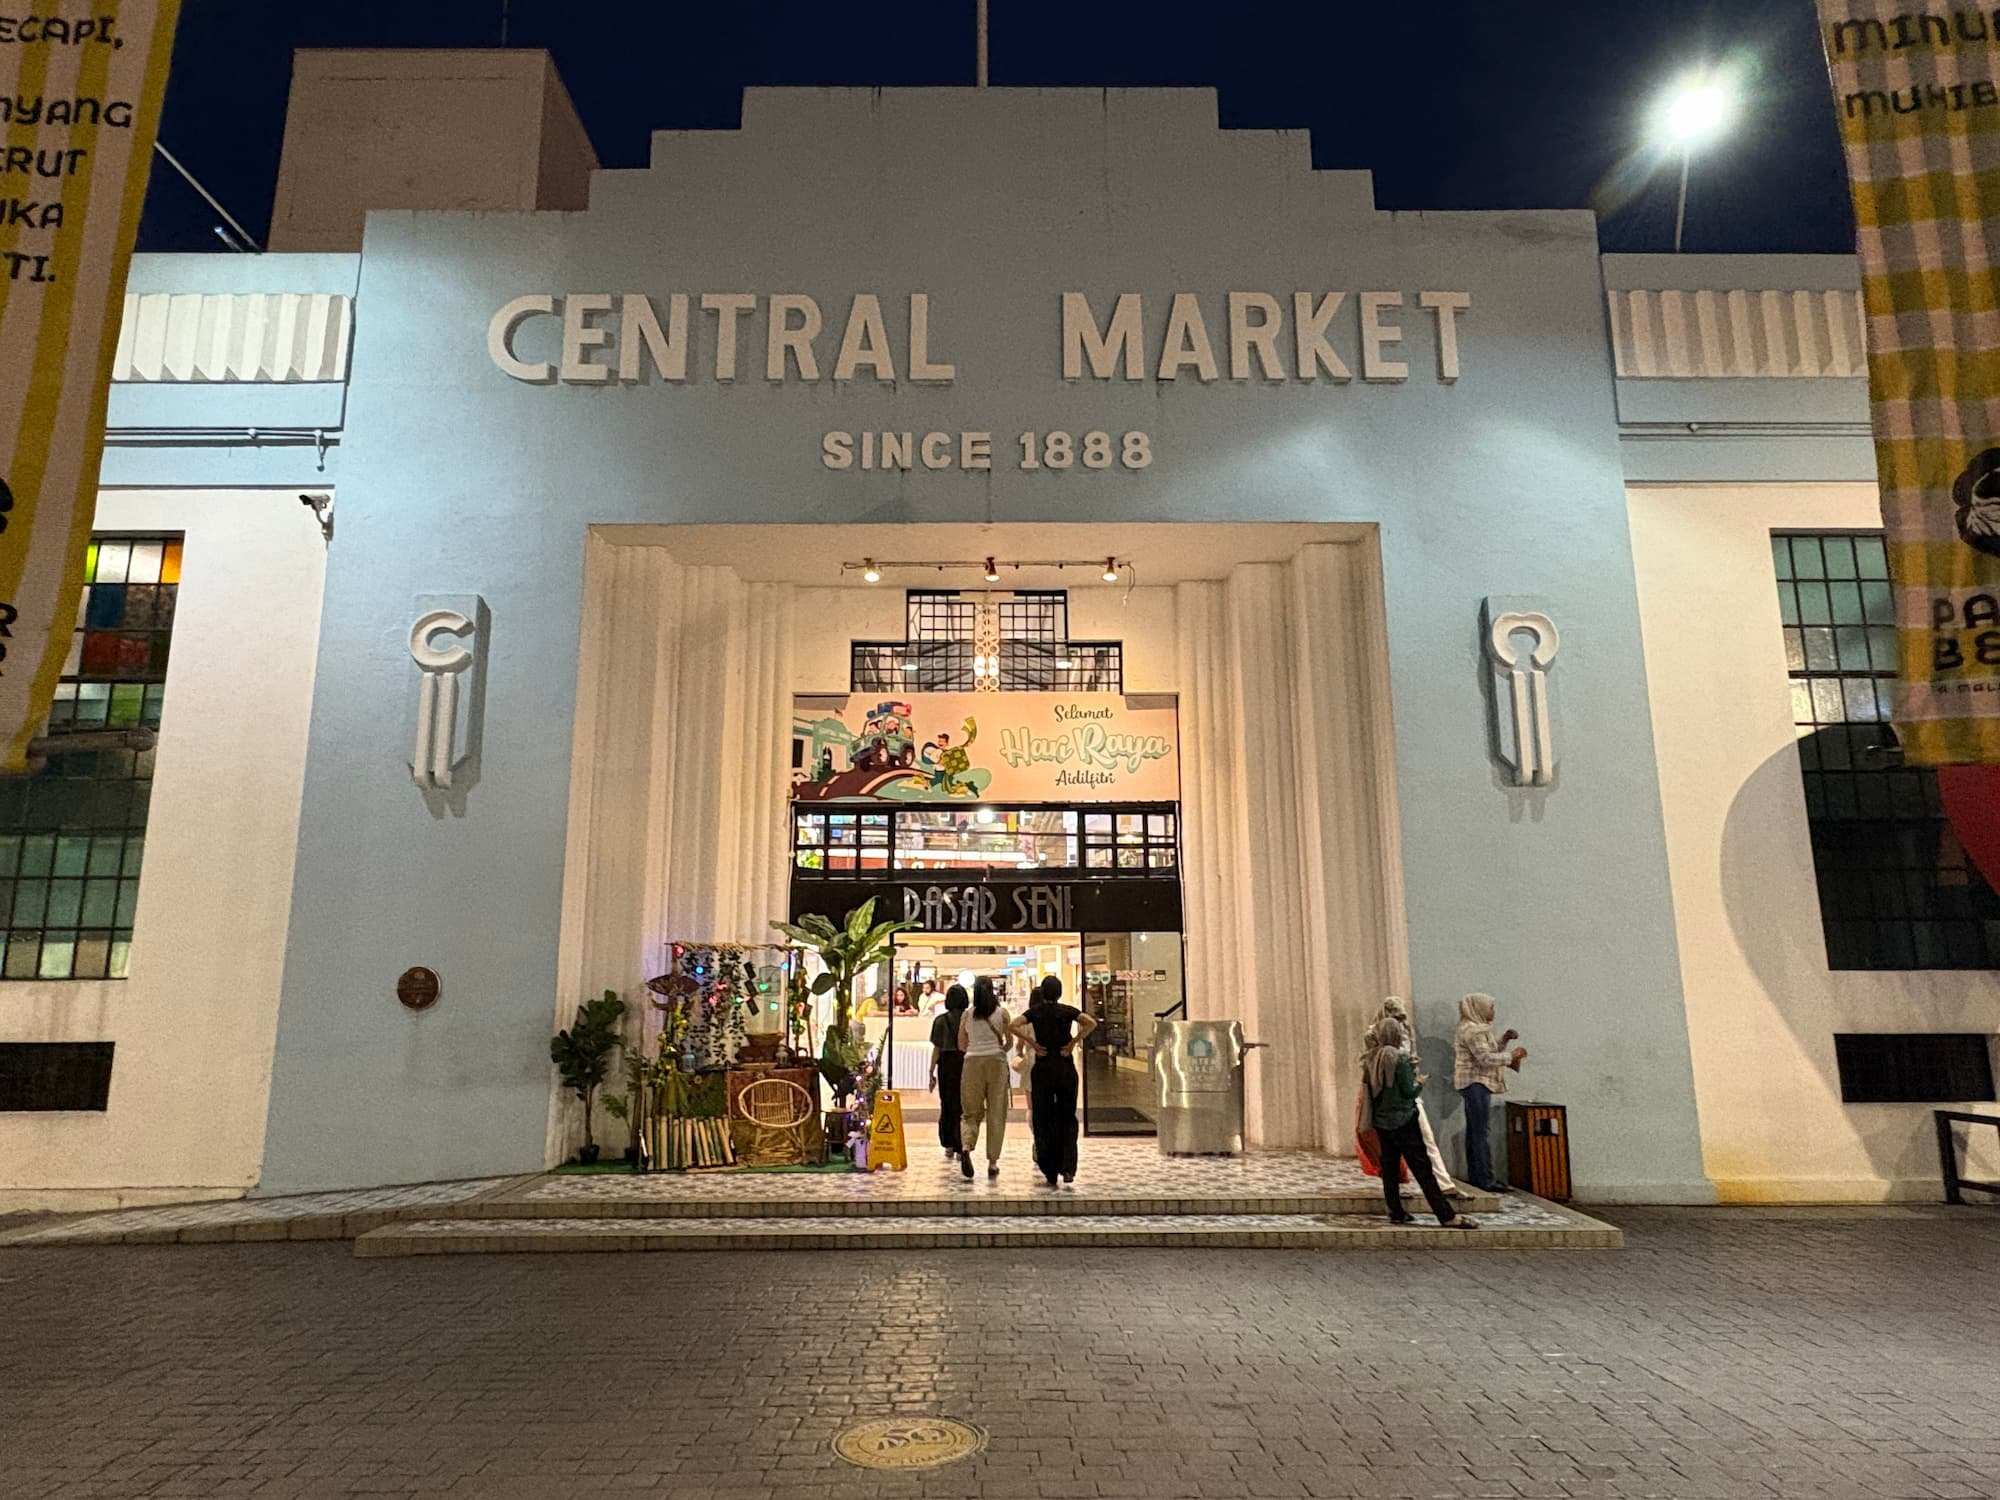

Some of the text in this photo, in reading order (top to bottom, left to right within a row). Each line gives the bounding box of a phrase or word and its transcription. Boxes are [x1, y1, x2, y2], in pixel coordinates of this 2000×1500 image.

[0, 146, 88, 178] RUT
[0, 199, 64, 229] KA
[4, 252, 56, 282] TI.
[488, 291, 1471, 384] CENTRAL MARKET
[822, 431, 1152, 470] SINCE 1888
[1054, 704, 1113, 722] Selamat
[1072, 722, 1171, 774] Raya
[1055, 769, 1116, 790] Aidilfitri
[903, 884, 1072, 931] PASAR SENI
